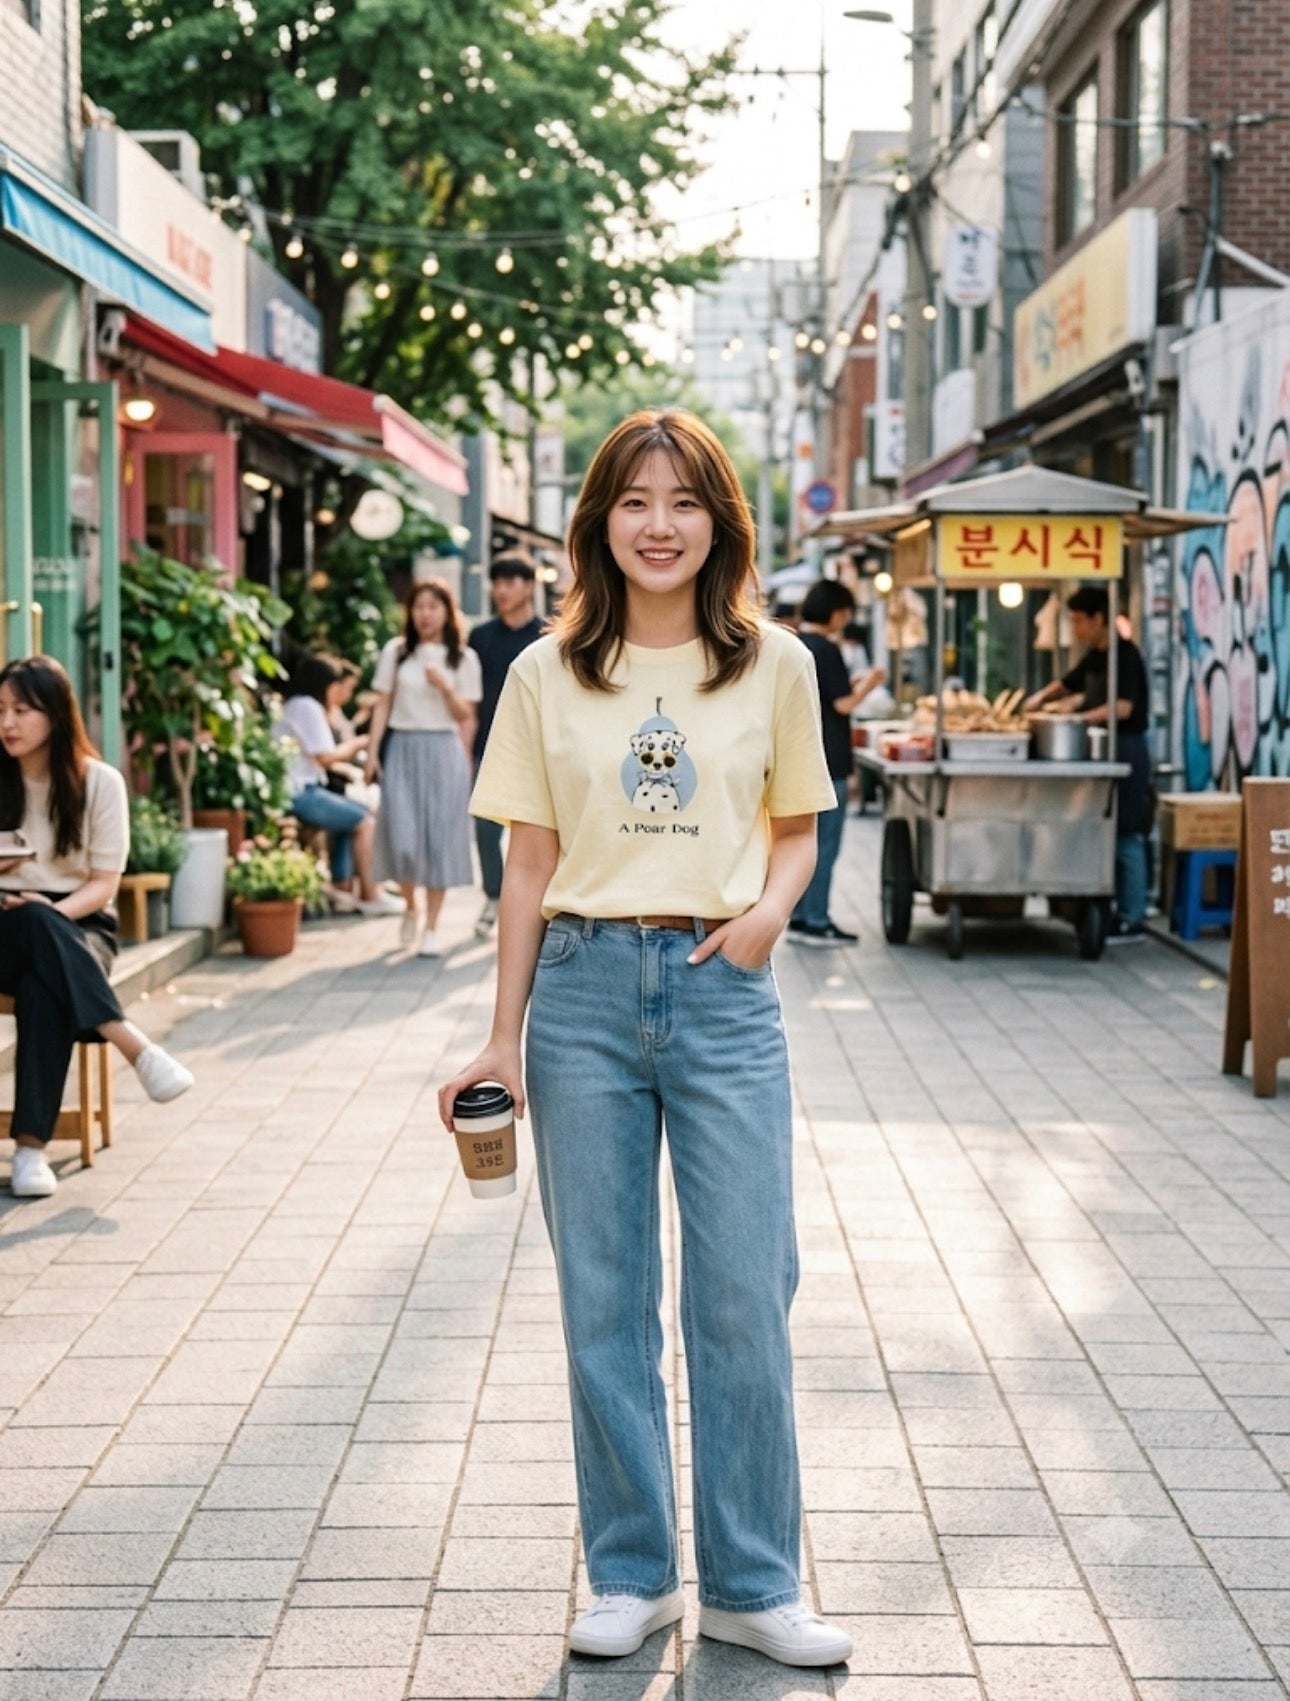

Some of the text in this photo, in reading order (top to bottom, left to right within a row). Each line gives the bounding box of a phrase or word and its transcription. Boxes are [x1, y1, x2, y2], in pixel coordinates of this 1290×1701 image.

[956, 524, 1103, 569] 분시식
[619, 823, 630, 833] A
[672, 823, 699, 837] Dog
